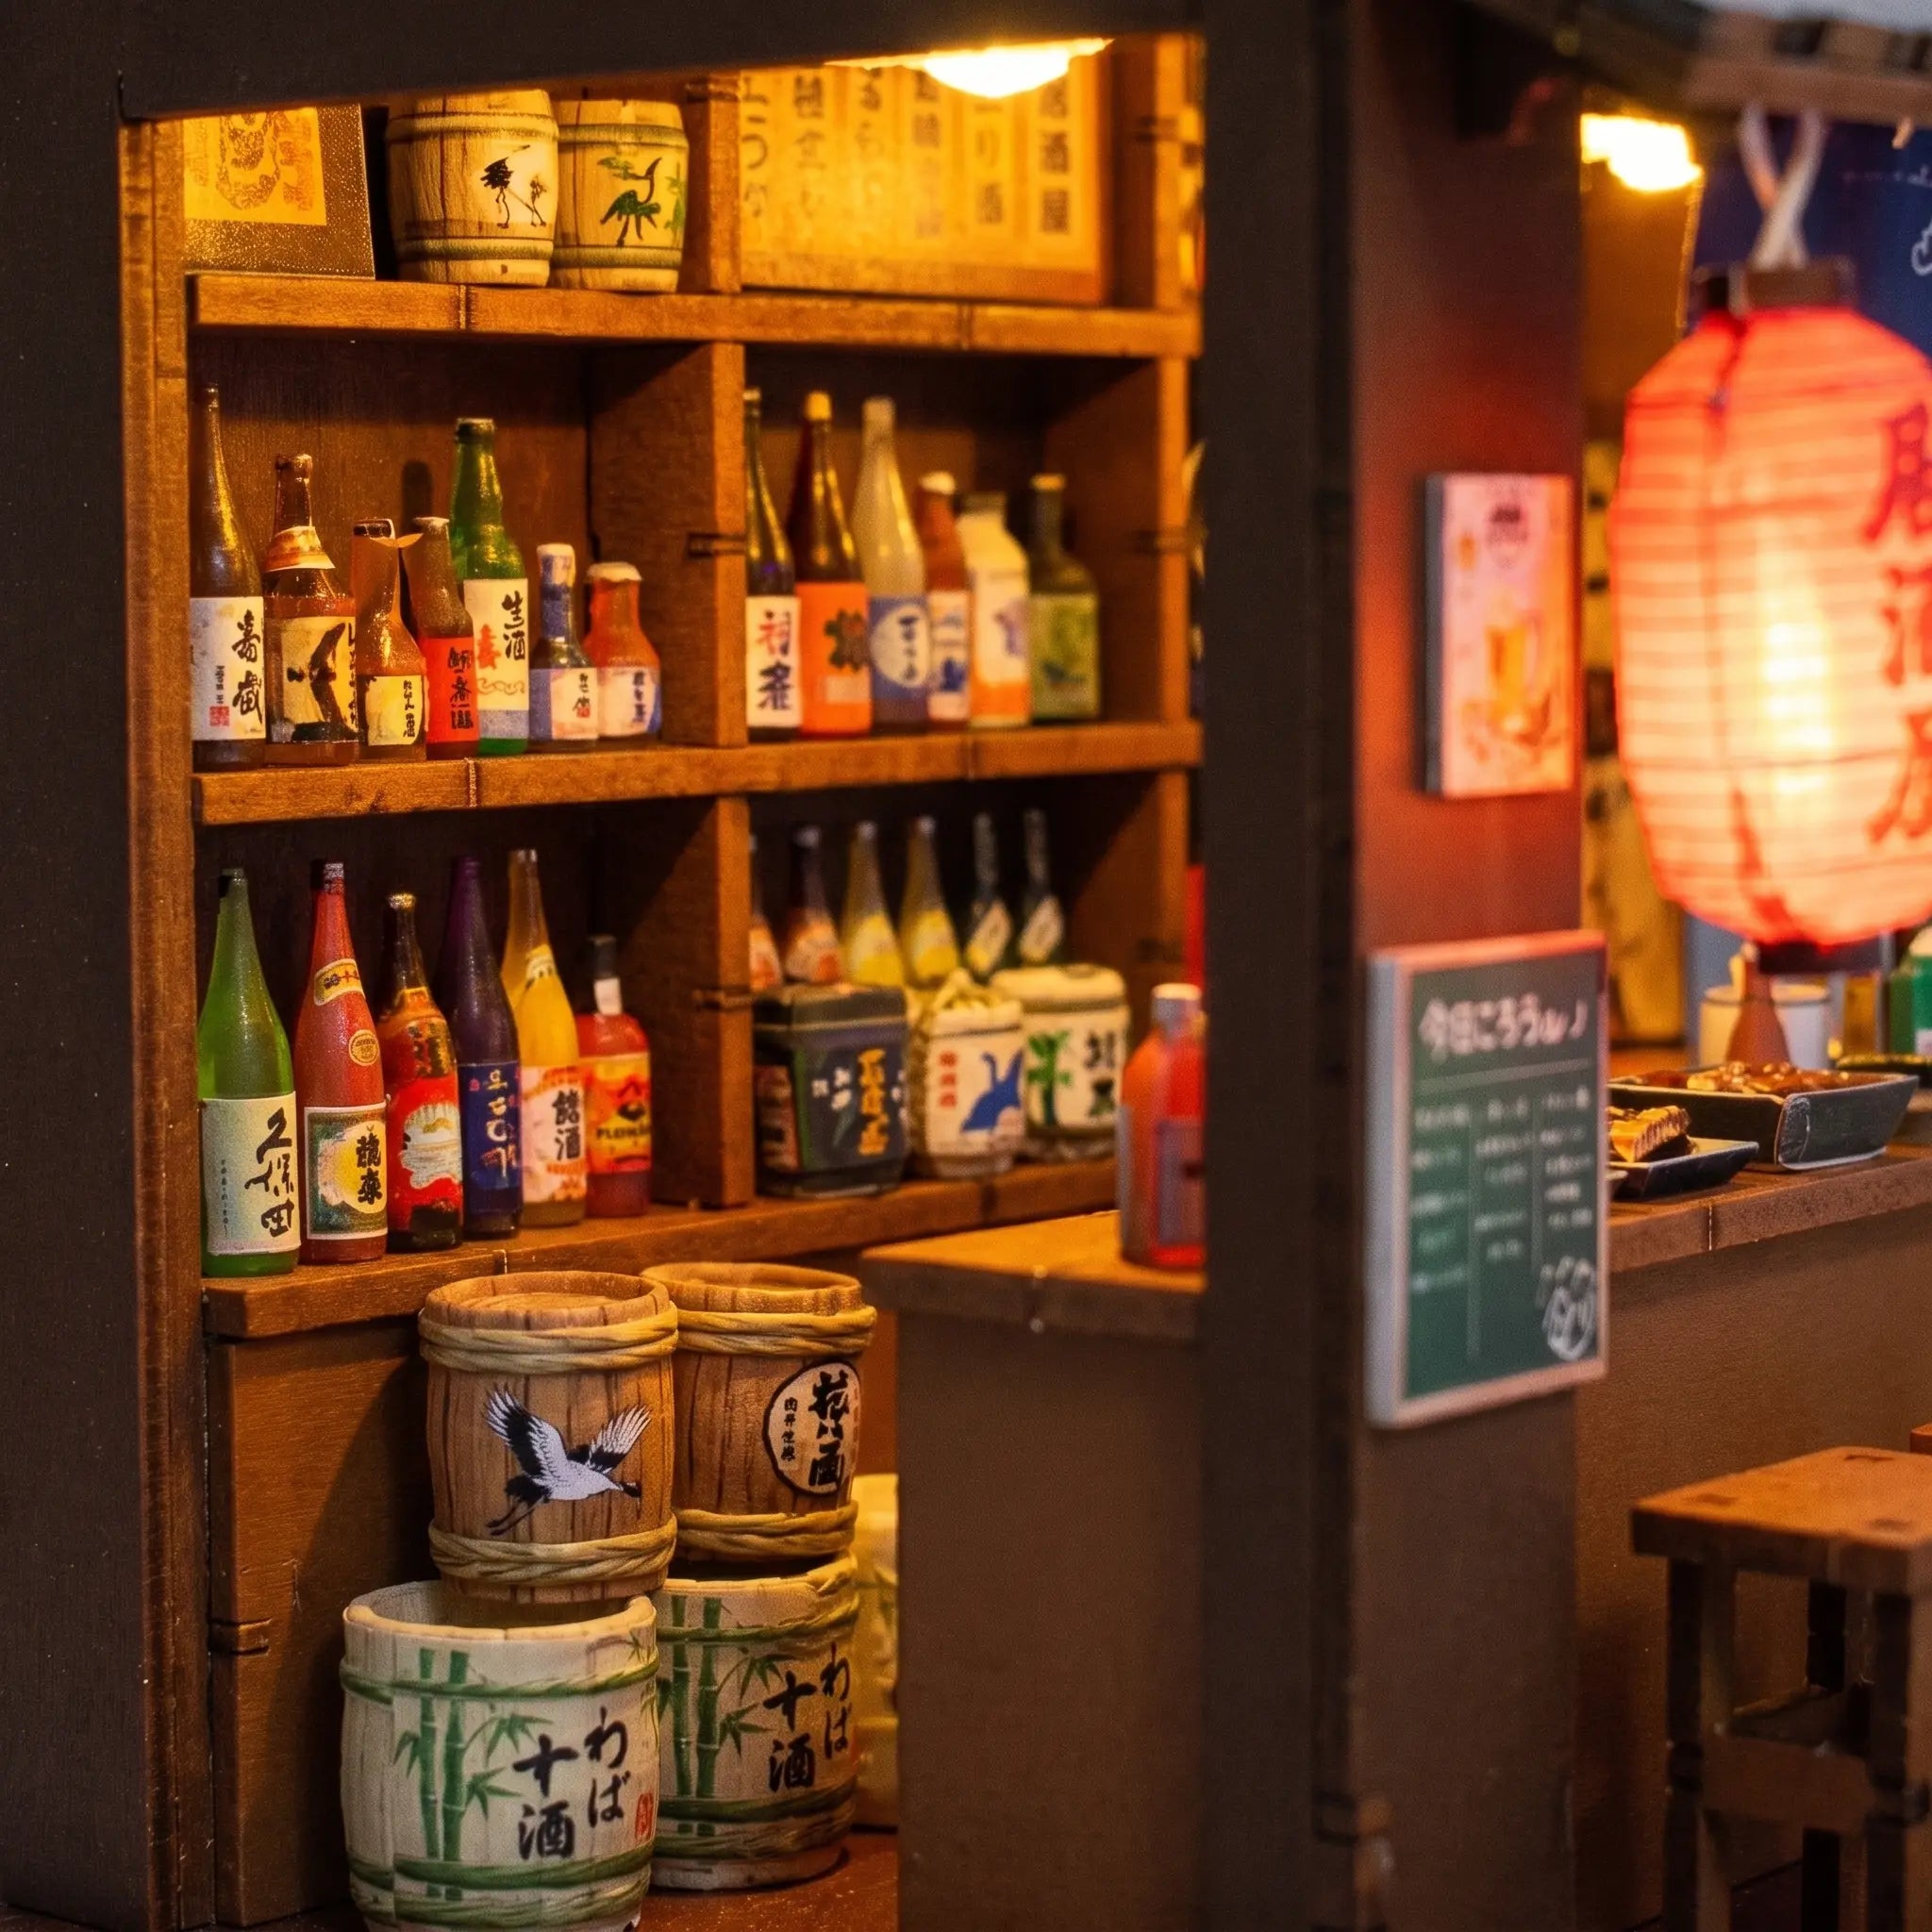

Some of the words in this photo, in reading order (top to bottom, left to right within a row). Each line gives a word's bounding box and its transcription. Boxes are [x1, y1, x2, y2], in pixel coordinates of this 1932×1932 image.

[501, 590, 526, 661] 生酒
[244, 1107, 296, 1238] 久保田
